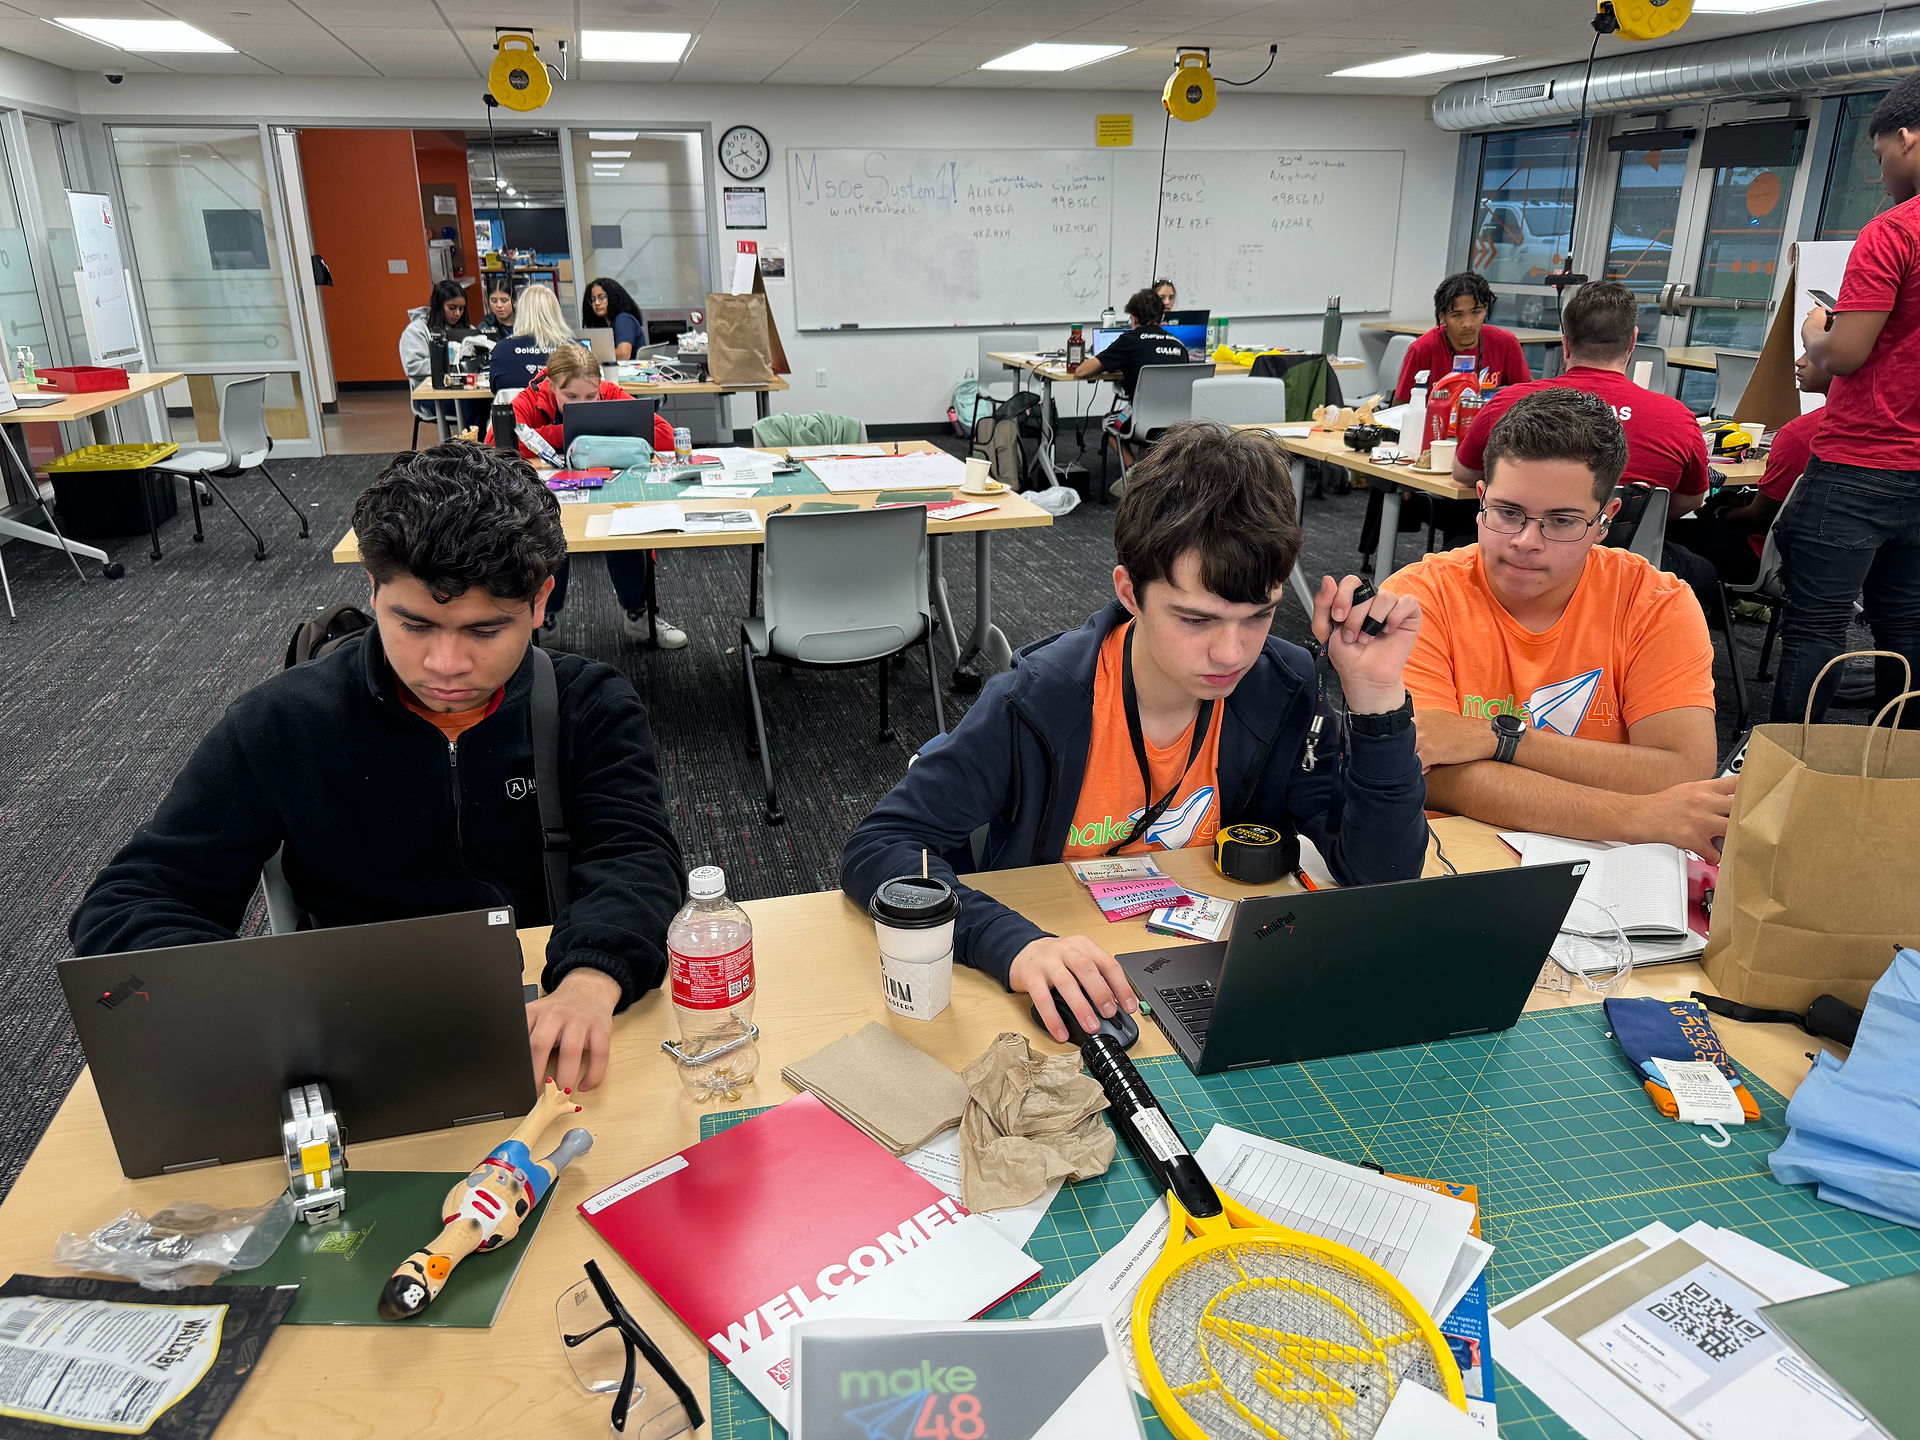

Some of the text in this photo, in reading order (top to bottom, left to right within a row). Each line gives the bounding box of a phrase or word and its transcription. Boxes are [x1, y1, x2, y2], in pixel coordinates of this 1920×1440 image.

[739, 131, 747, 139] 12
[751, 164, 756, 172] 5
[1102, 881, 1165, 893] INNOVATING
[1114, 888, 1167, 901] OPERATING
[1114, 896, 1178, 914] WORKING WITH
[1123, 893, 1165, 905] OBJECTS
[1120, 901, 1178, 917] INFORMATION
[495, 914, 502, 922] 5
[1253, 911, 1296, 941] ThinkPad
[596, 1191, 621, 1208] Elias
[708, 1195, 970, 1362] WELCOME!
[1107, 1269, 1126, 1291] AGILITIES
[151, 1318, 200, 1372] WALLABY
[840, 1360, 978, 1399] make
[913, 1393, 986, 1440] 48
